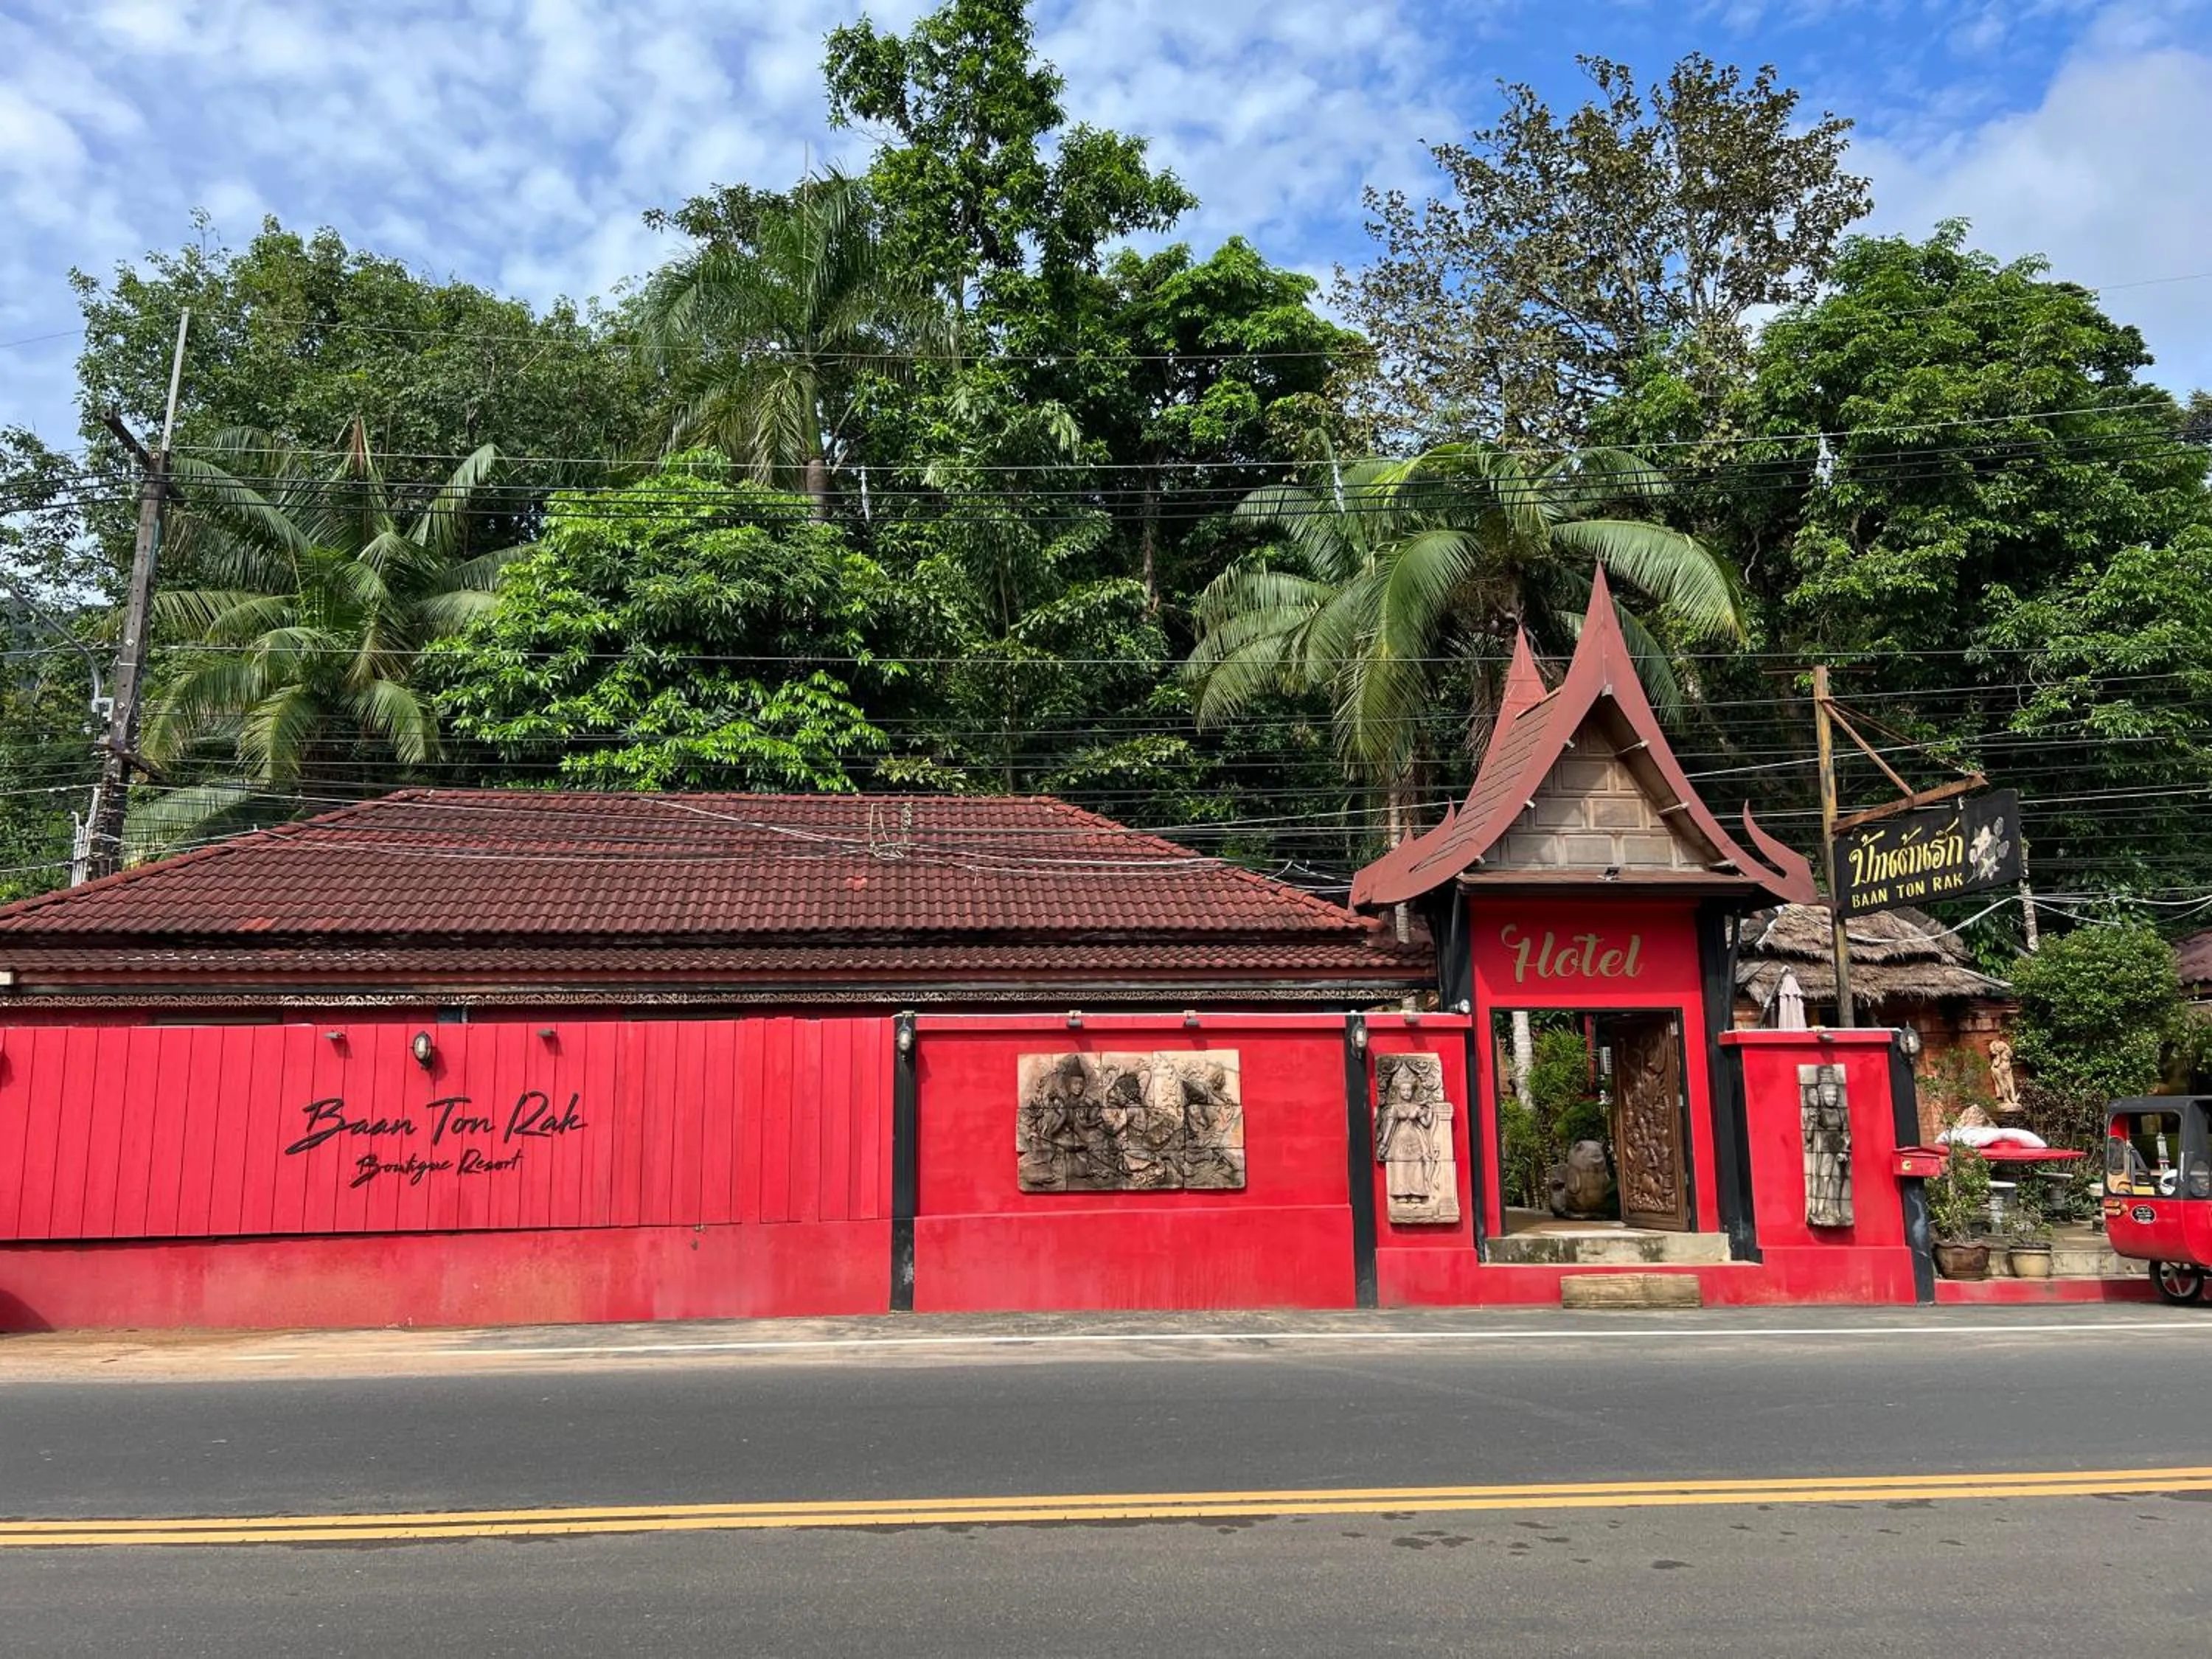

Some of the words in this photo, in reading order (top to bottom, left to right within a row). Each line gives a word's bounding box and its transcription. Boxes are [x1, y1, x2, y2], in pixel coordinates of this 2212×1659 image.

[1851, 888, 1888, 908] BAAN
[1896, 880, 1925, 899] TON
[1933, 872, 1964, 891] RAK
[1500, 923, 1644, 983] Hotel
[285, 1098, 418, 1155] Baan
[425, 1096, 495, 1145] Ton
[503, 1091, 588, 1144] Rak
[350, 1152, 453, 1189] Boutique
[456, 1149, 524, 1177] Resort
